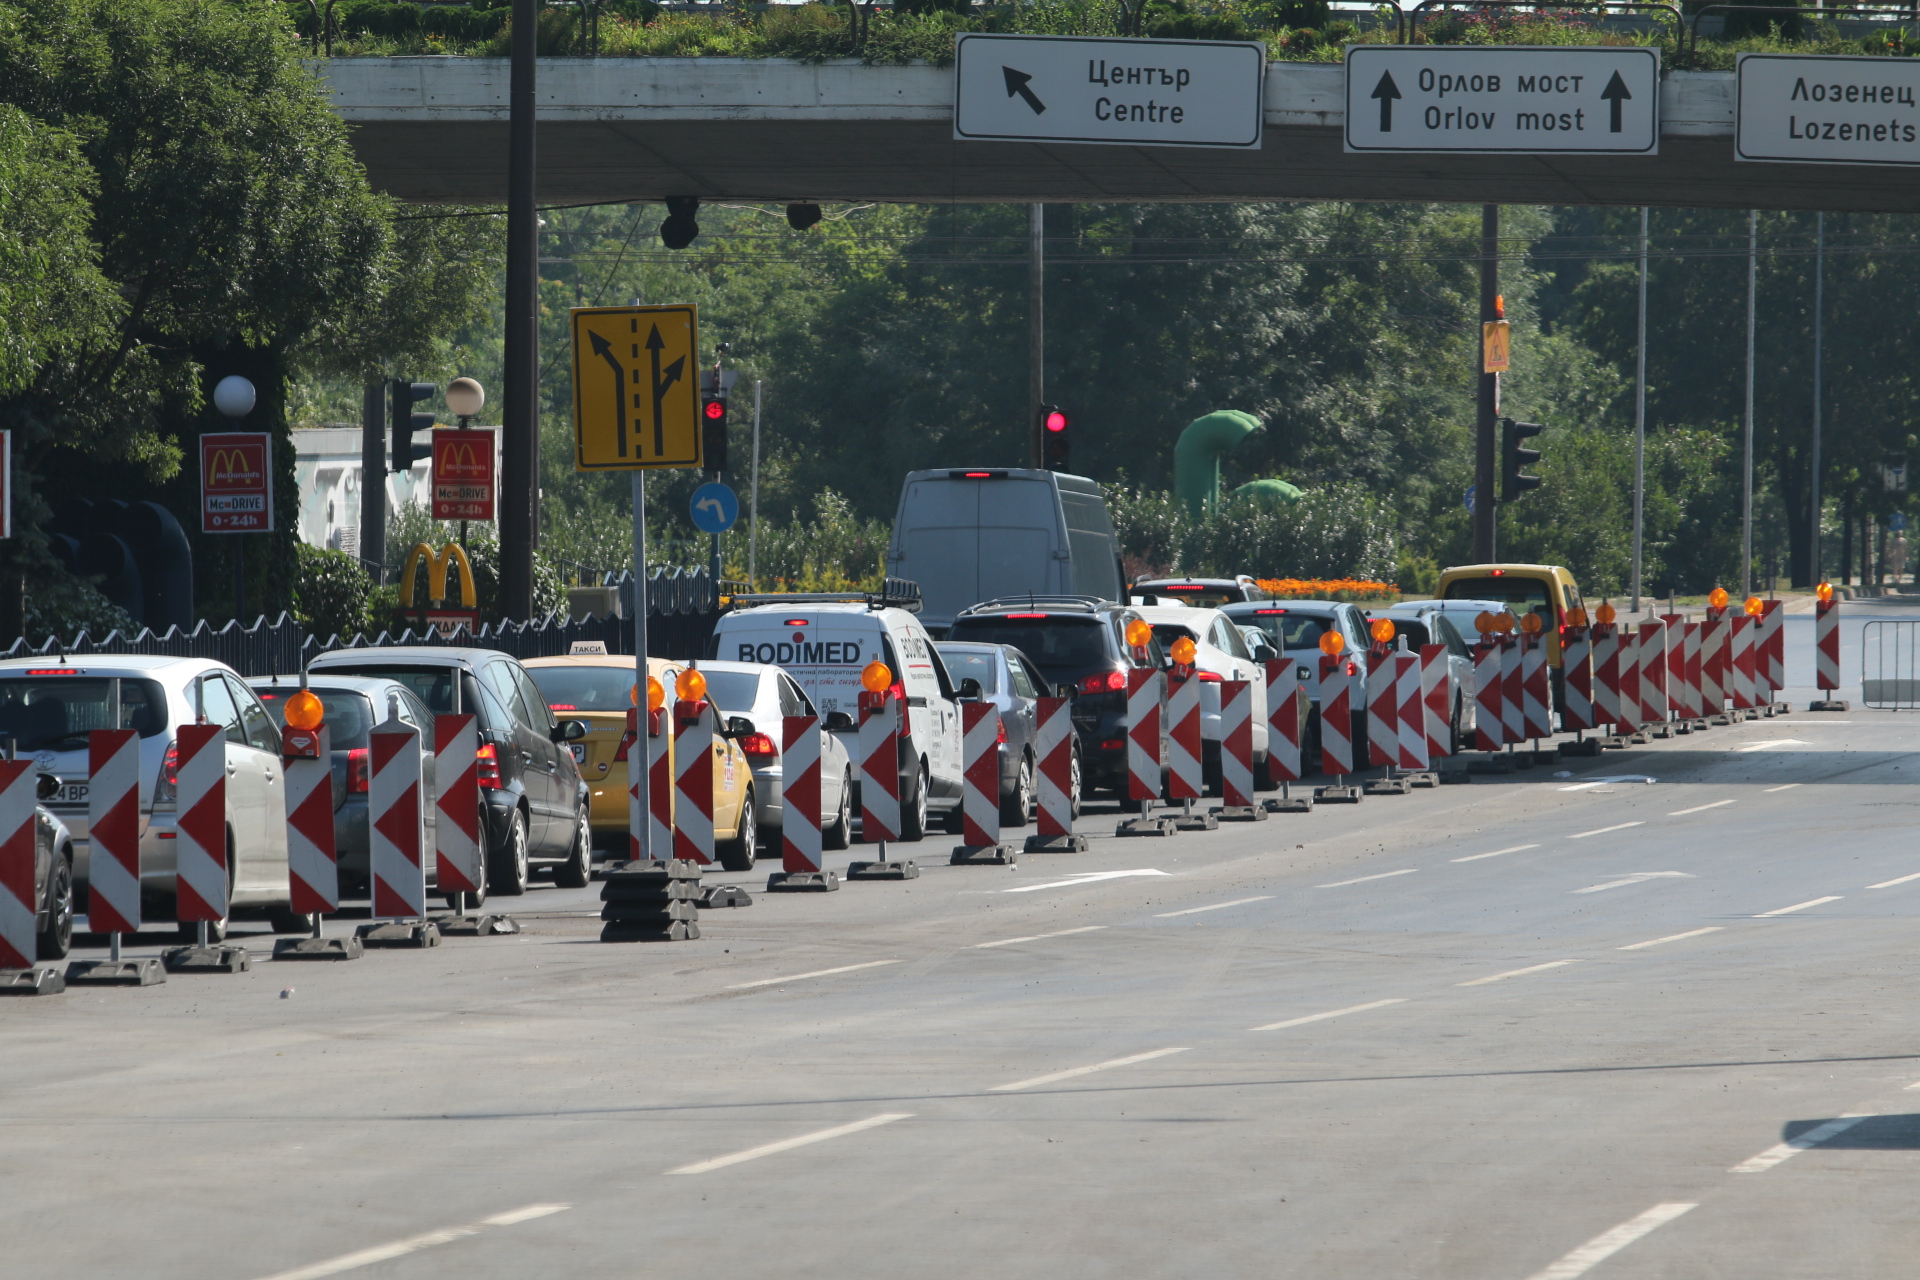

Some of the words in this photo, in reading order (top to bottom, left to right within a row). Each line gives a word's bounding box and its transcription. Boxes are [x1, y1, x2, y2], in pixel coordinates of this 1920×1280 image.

[1089, 59, 1190, 92] Център
[1419, 68, 1501, 98] Орлов
[1518, 75, 1583, 93] мост
[1790, 77, 1915, 107] Лозенец
[1095, 97, 1184, 123] Centre
[1425, 106, 1495, 130] Orlov
[1517, 109, 1584, 131] most
[1789, 115, 1916, 142] Lozenets
